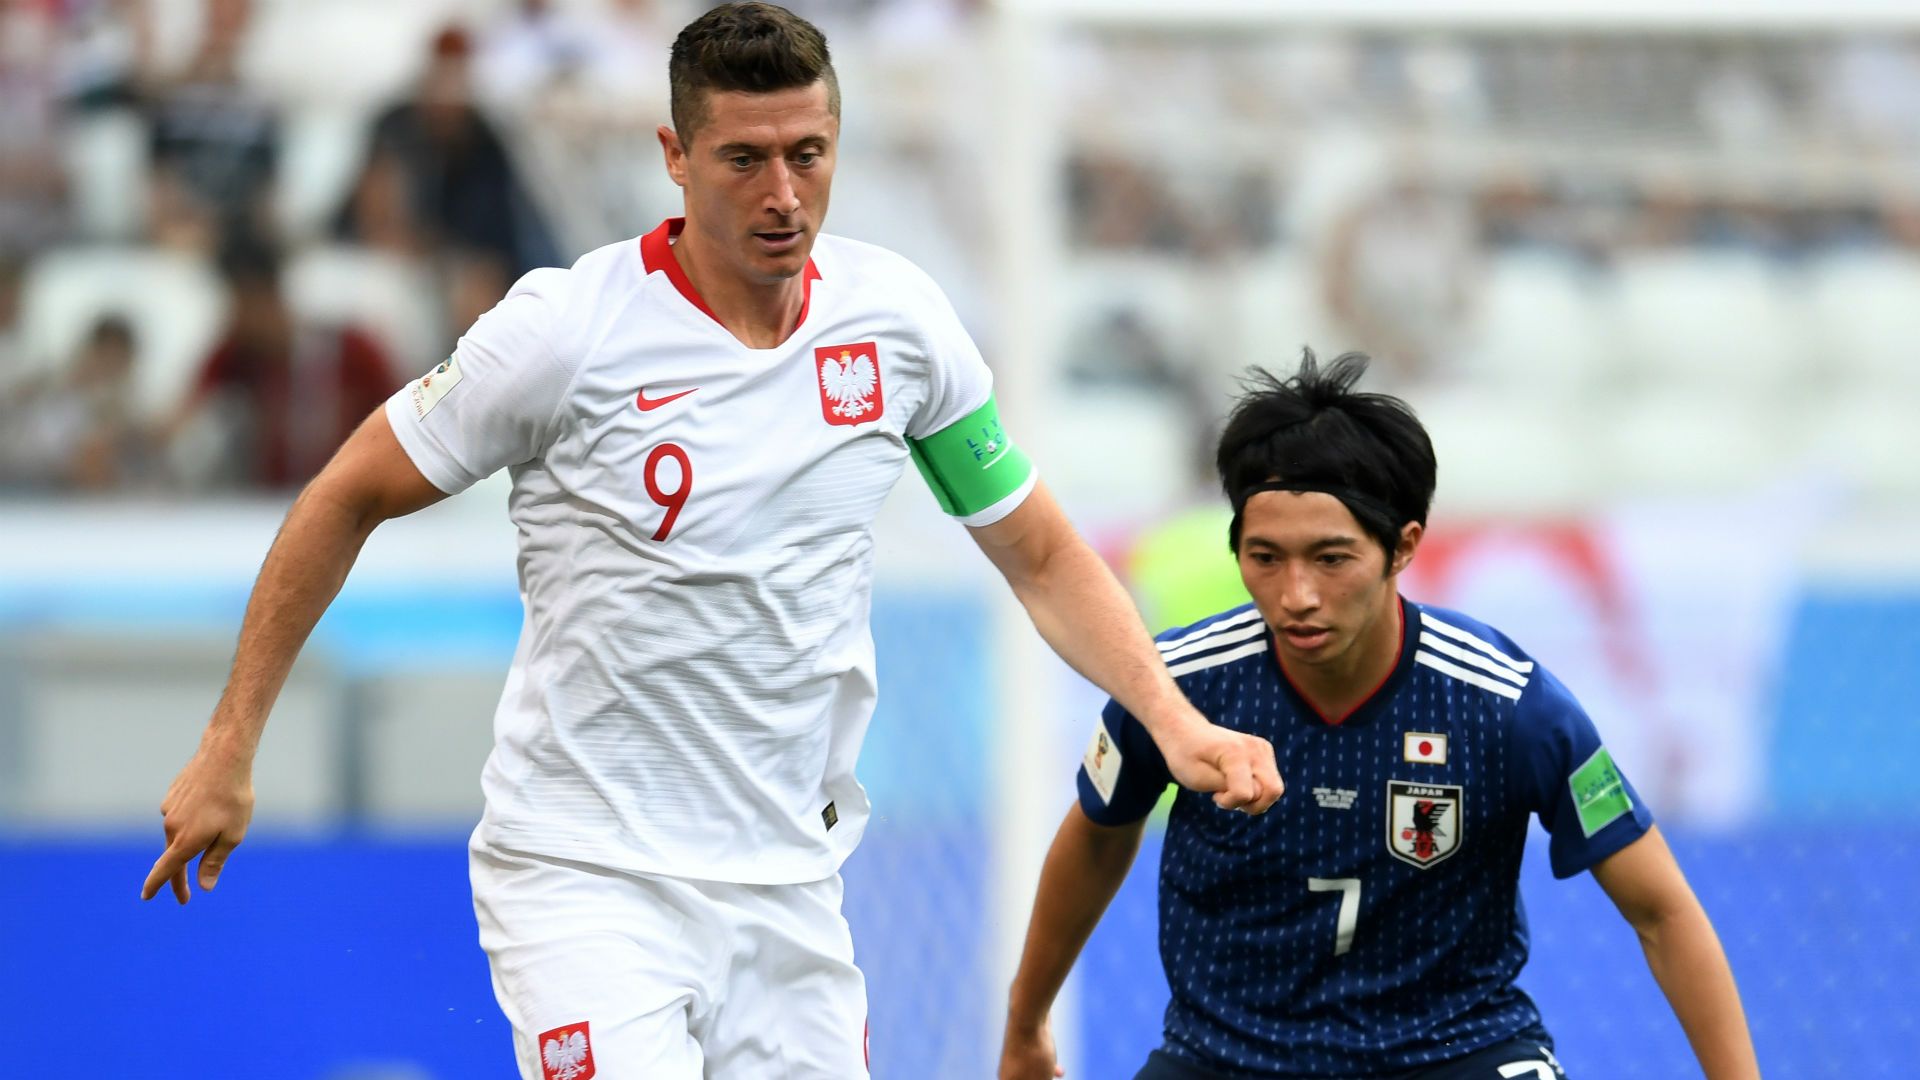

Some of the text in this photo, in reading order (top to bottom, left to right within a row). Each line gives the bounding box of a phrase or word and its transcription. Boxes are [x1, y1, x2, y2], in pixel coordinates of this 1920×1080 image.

[643, 443, 693, 542] 9
[1406, 786, 1444, 797] JAPAN
[1308, 877, 1362, 956] 7
